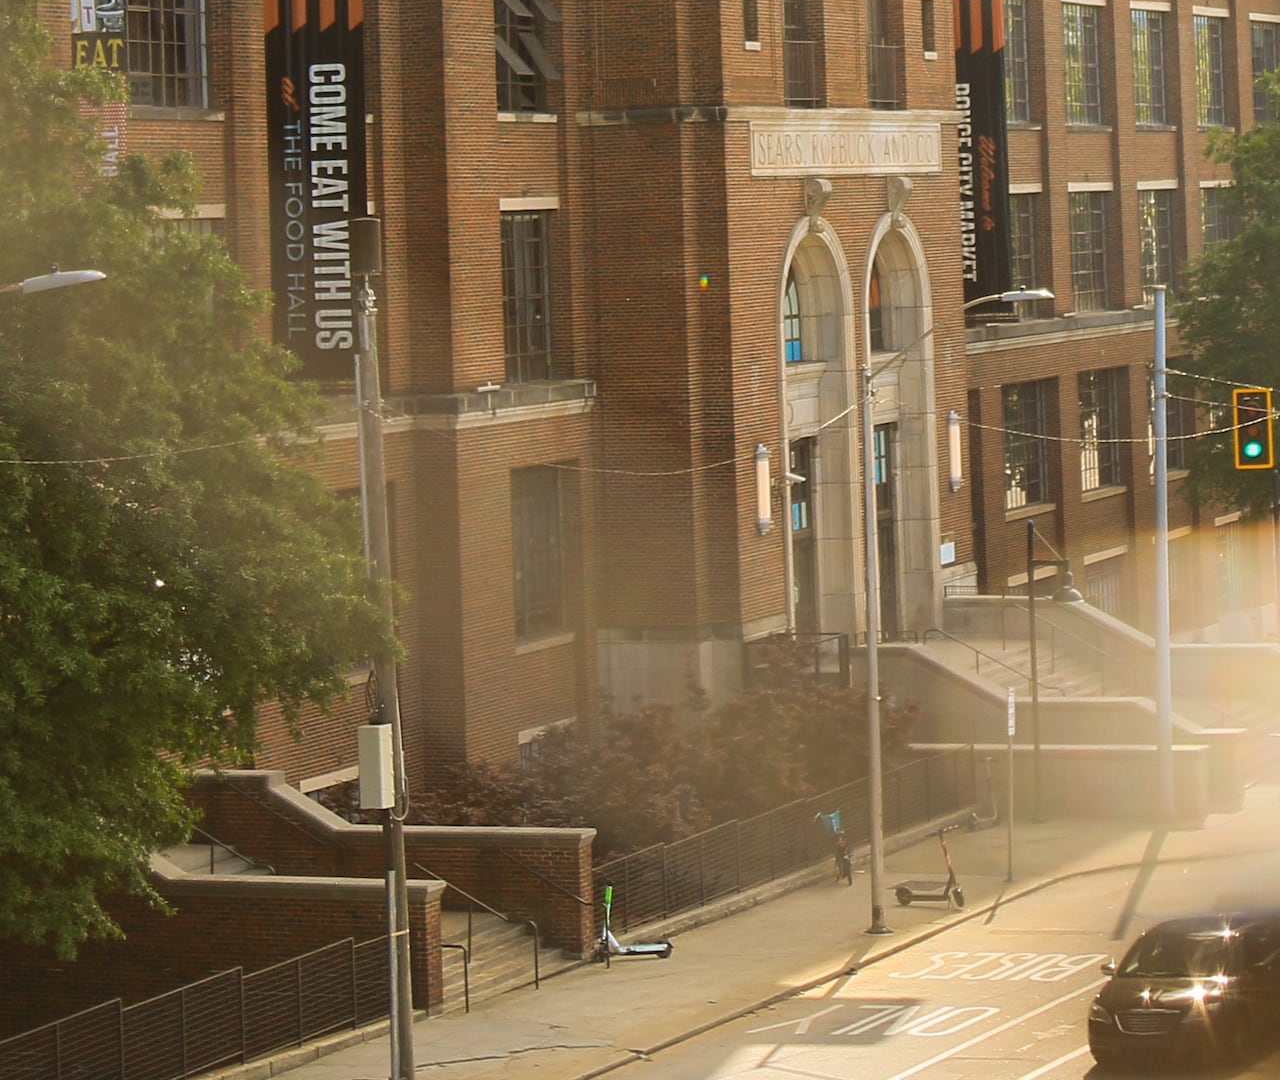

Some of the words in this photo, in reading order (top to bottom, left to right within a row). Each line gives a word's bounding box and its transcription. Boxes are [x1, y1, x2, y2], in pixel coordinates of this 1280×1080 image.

[75, 38, 124, 69] EAT
[308, 62, 348, 152] COME
[282, 119, 302, 172] THE
[811, 133, 876, 164] ROEBUCK
[883, 133, 911, 164] AND
[310, 158, 350, 213] EAT
[284, 182, 305, 262] FOOD
[312, 219, 352, 301] WITH
[286, 272, 307, 340] HALL
[314, 308, 353, 350] US
[889, 951, 1109, 983] BUSES
[745, 1003, 1001, 1037] ONLY
